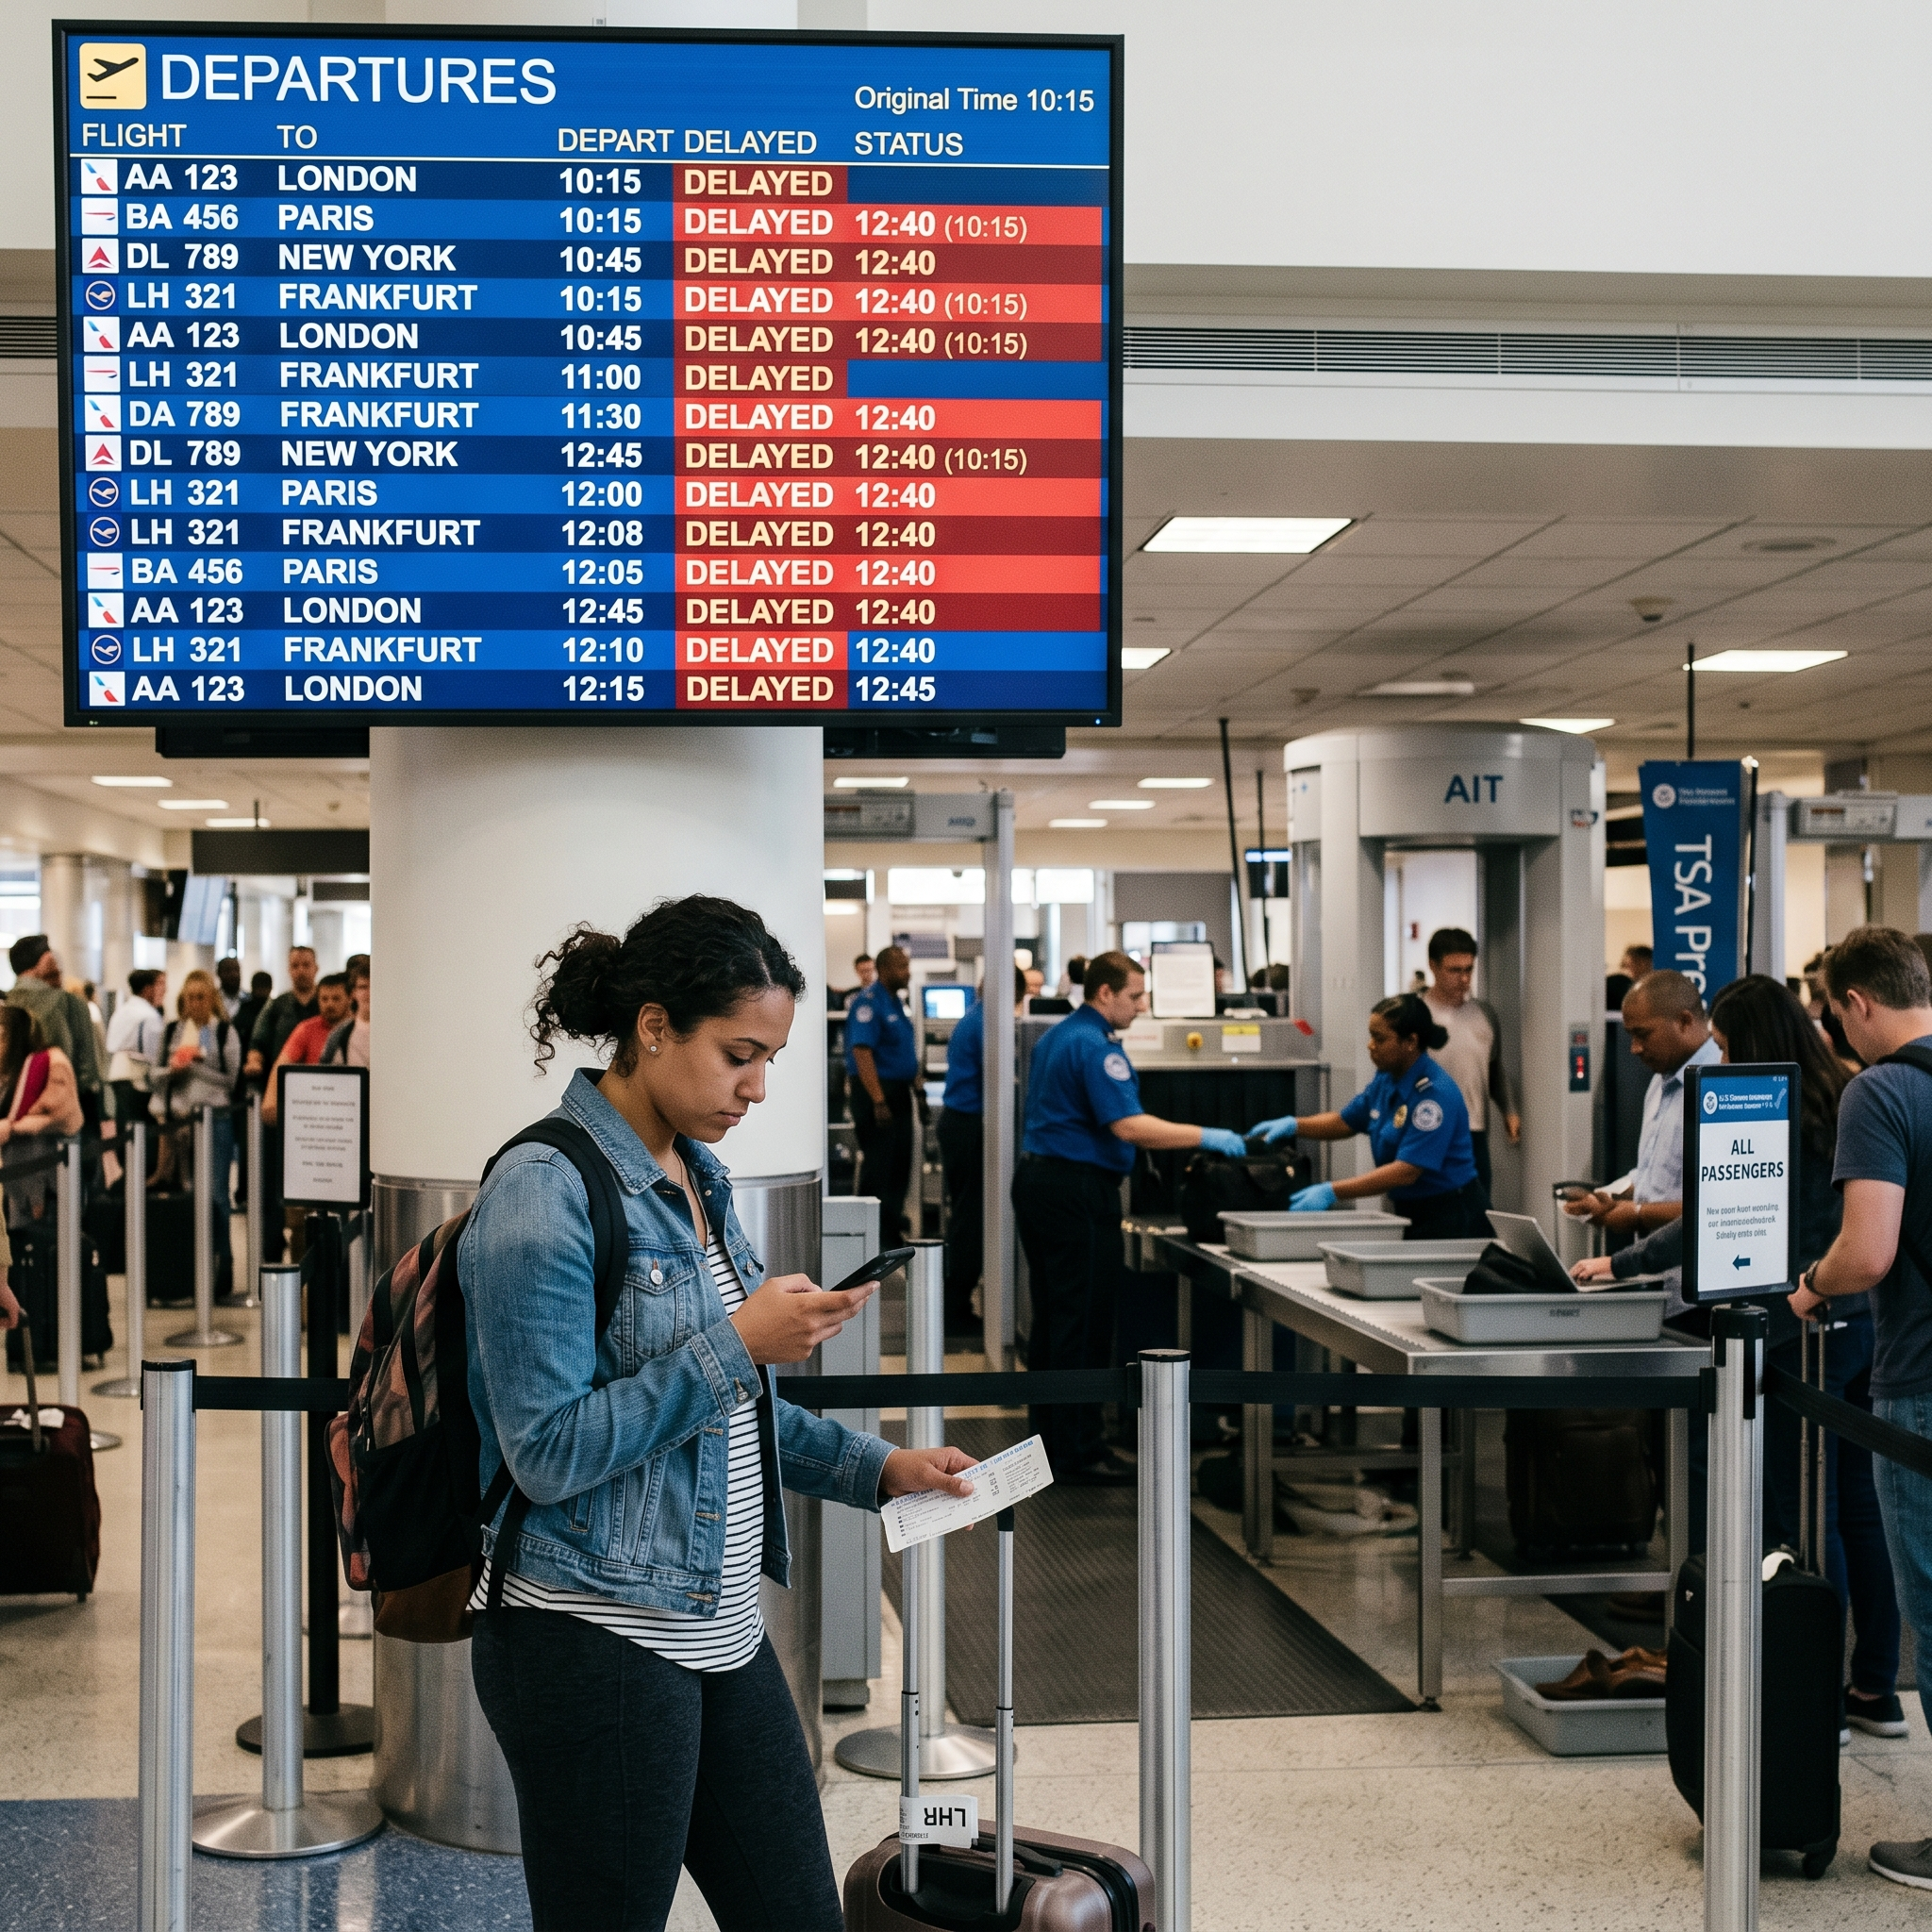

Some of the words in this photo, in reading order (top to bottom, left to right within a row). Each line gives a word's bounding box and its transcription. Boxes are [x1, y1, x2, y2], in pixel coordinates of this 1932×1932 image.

[161, 54, 557, 105] DEPARTURES
[855, 86, 950, 115] Original
[957, 87, 1018, 111] Time
[1027, 89, 1094, 112] 10:15
[82, 123, 188, 147] FLIGHT
[276, 125, 318, 149] TO
[558, 127, 675, 153] DEPART
[685, 129, 817, 155] DELAYED
[855, 131, 963, 157] STATUS
[124, 163, 173, 190] AA
[185, 163, 238, 191] 123
[278, 164, 417, 192] LONDON
[559, 167, 641, 194] 10:15
[684, 169, 833, 196] DELAYED
[126, 203, 174, 229] BA
[183, 203, 239, 230] 456
[278, 204, 375, 231] PARIS
[559, 207, 641, 234] 10:15
[684, 208, 834, 236] DELAYED
[855, 209, 936, 237] 12:40
[944, 214, 1027, 243] (10:15)
[126, 242, 170, 269] DL
[184, 242, 239, 270] 789
[278, 243, 355, 271] NEW
[361, 244, 457, 272] YORK
[559, 246, 641, 273] 10:45
[685, 247, 833, 275] DELAYED
[855, 249, 936, 275] 12:40
[127, 282, 169, 308] LH
[185, 282, 235, 309] 321
[279, 283, 478, 310] FRANKFURT
[560, 285, 642, 312] 10:15
[685, 286, 834, 313] DELAYED
[855, 288, 936, 315] 12:40
[944, 291, 1027, 321] (10:15)
[126, 322, 175, 348] AA
[187, 322, 240, 348] 123
[280, 322, 418, 349] LONDON
[560, 324, 642, 351] 10:45
[685, 325, 834, 353] DELAYED
[856, 327, 936, 354] 12:40
[944, 331, 1027, 359] (10:15)
[129, 360, 171, 388] LH
[186, 361, 236, 388] 321
[280, 361, 479, 389] FRANKFURT
[561, 363, 641, 391] 11:00
[685, 364, 834, 391] DELAYED
[129, 400, 176, 427] DA
[186, 401, 241, 427] 789
[281, 401, 479, 428] FRANKFURT
[561, 403, 641, 429] 11:30
[685, 403, 834, 430] DELAYED
[855, 404, 936, 431] 12:40
[129, 440, 173, 466] DL
[187, 440, 241, 467] 789
[281, 441, 358, 466] NEW
[364, 441, 458, 467] YORK
[561, 441, 642, 468] 12:45
[686, 442, 834, 469] DELAYED
[855, 443, 936, 470] 12:40
[944, 447, 1027, 475] (10:15)
[130, 479, 172, 506] LH
[187, 479, 238, 506] 321
[282, 479, 378, 507] PARIS
[561, 480, 642, 508] 12:00
[686, 481, 834, 508] DELAYED
[855, 481, 936, 508] 12:40
[131, 518, 173, 545] LH
[188, 519, 239, 545] 321
[282, 519, 481, 546] FRANKFURT
[561, 520, 643, 546] 12:08
[686, 521, 834, 547] DELAYED
[856, 521, 936, 547] 12:40
[131, 558, 178, 584] BA
[188, 558, 243, 584] 456
[283, 558, 378, 585] PARIS
[562, 558, 643, 585] 12:05
[686, 559, 834, 586] DELAYED
[856, 559, 936, 587] 12:40
[130, 597, 179, 624] AA
[190, 597, 243, 624] 123
[284, 596, 421, 624] LONDON
[562, 597, 644, 625] 12:45
[686, 598, 834, 625] DELAYED
[856, 599, 936, 625] 12:40
[133, 637, 175, 662] LH
[190, 636, 241, 662] 321
[284, 637, 482, 663] FRANKFURT
[562, 637, 643, 663] 12:10
[686, 637, 834, 663] DELAYED
[856, 638, 936, 663] 12:40
[131, 675, 180, 701] AA
[192, 675, 245, 702] 123
[285, 675, 422, 702] LONDON
[563, 675, 644, 702] 12:15
[687, 675, 834, 702] DELAYED
[856, 675, 936, 702] 12:45
[1444, 774, 1504, 804] AIT
[1674, 834, 1713, 916] TSA
[1731, 1138, 1755, 1156] ALL
[1701, 1161, 1784, 1182] PASSENGERS
[924, 1807, 966, 1827] LHR
